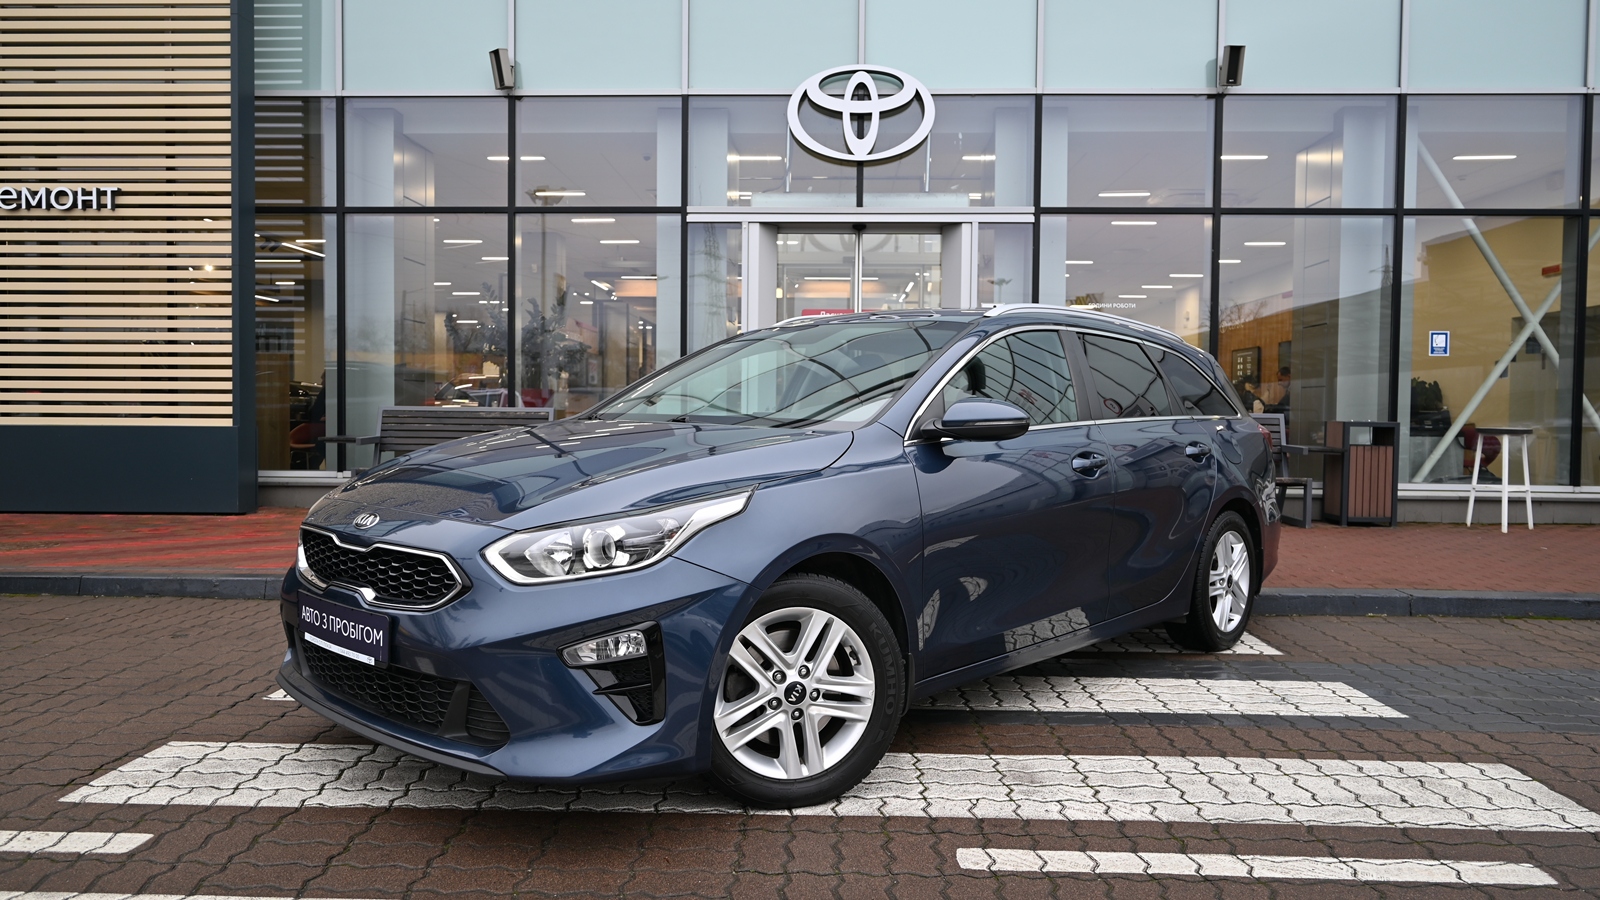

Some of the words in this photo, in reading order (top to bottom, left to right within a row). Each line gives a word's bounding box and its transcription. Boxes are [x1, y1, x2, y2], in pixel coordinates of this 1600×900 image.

[301, 605, 320, 626] АВТО
[329, 615, 383, 647] ПРОБІГОМ
[868, 622, 896, 715] KUMHO
[788, 684, 803, 702] KIA
